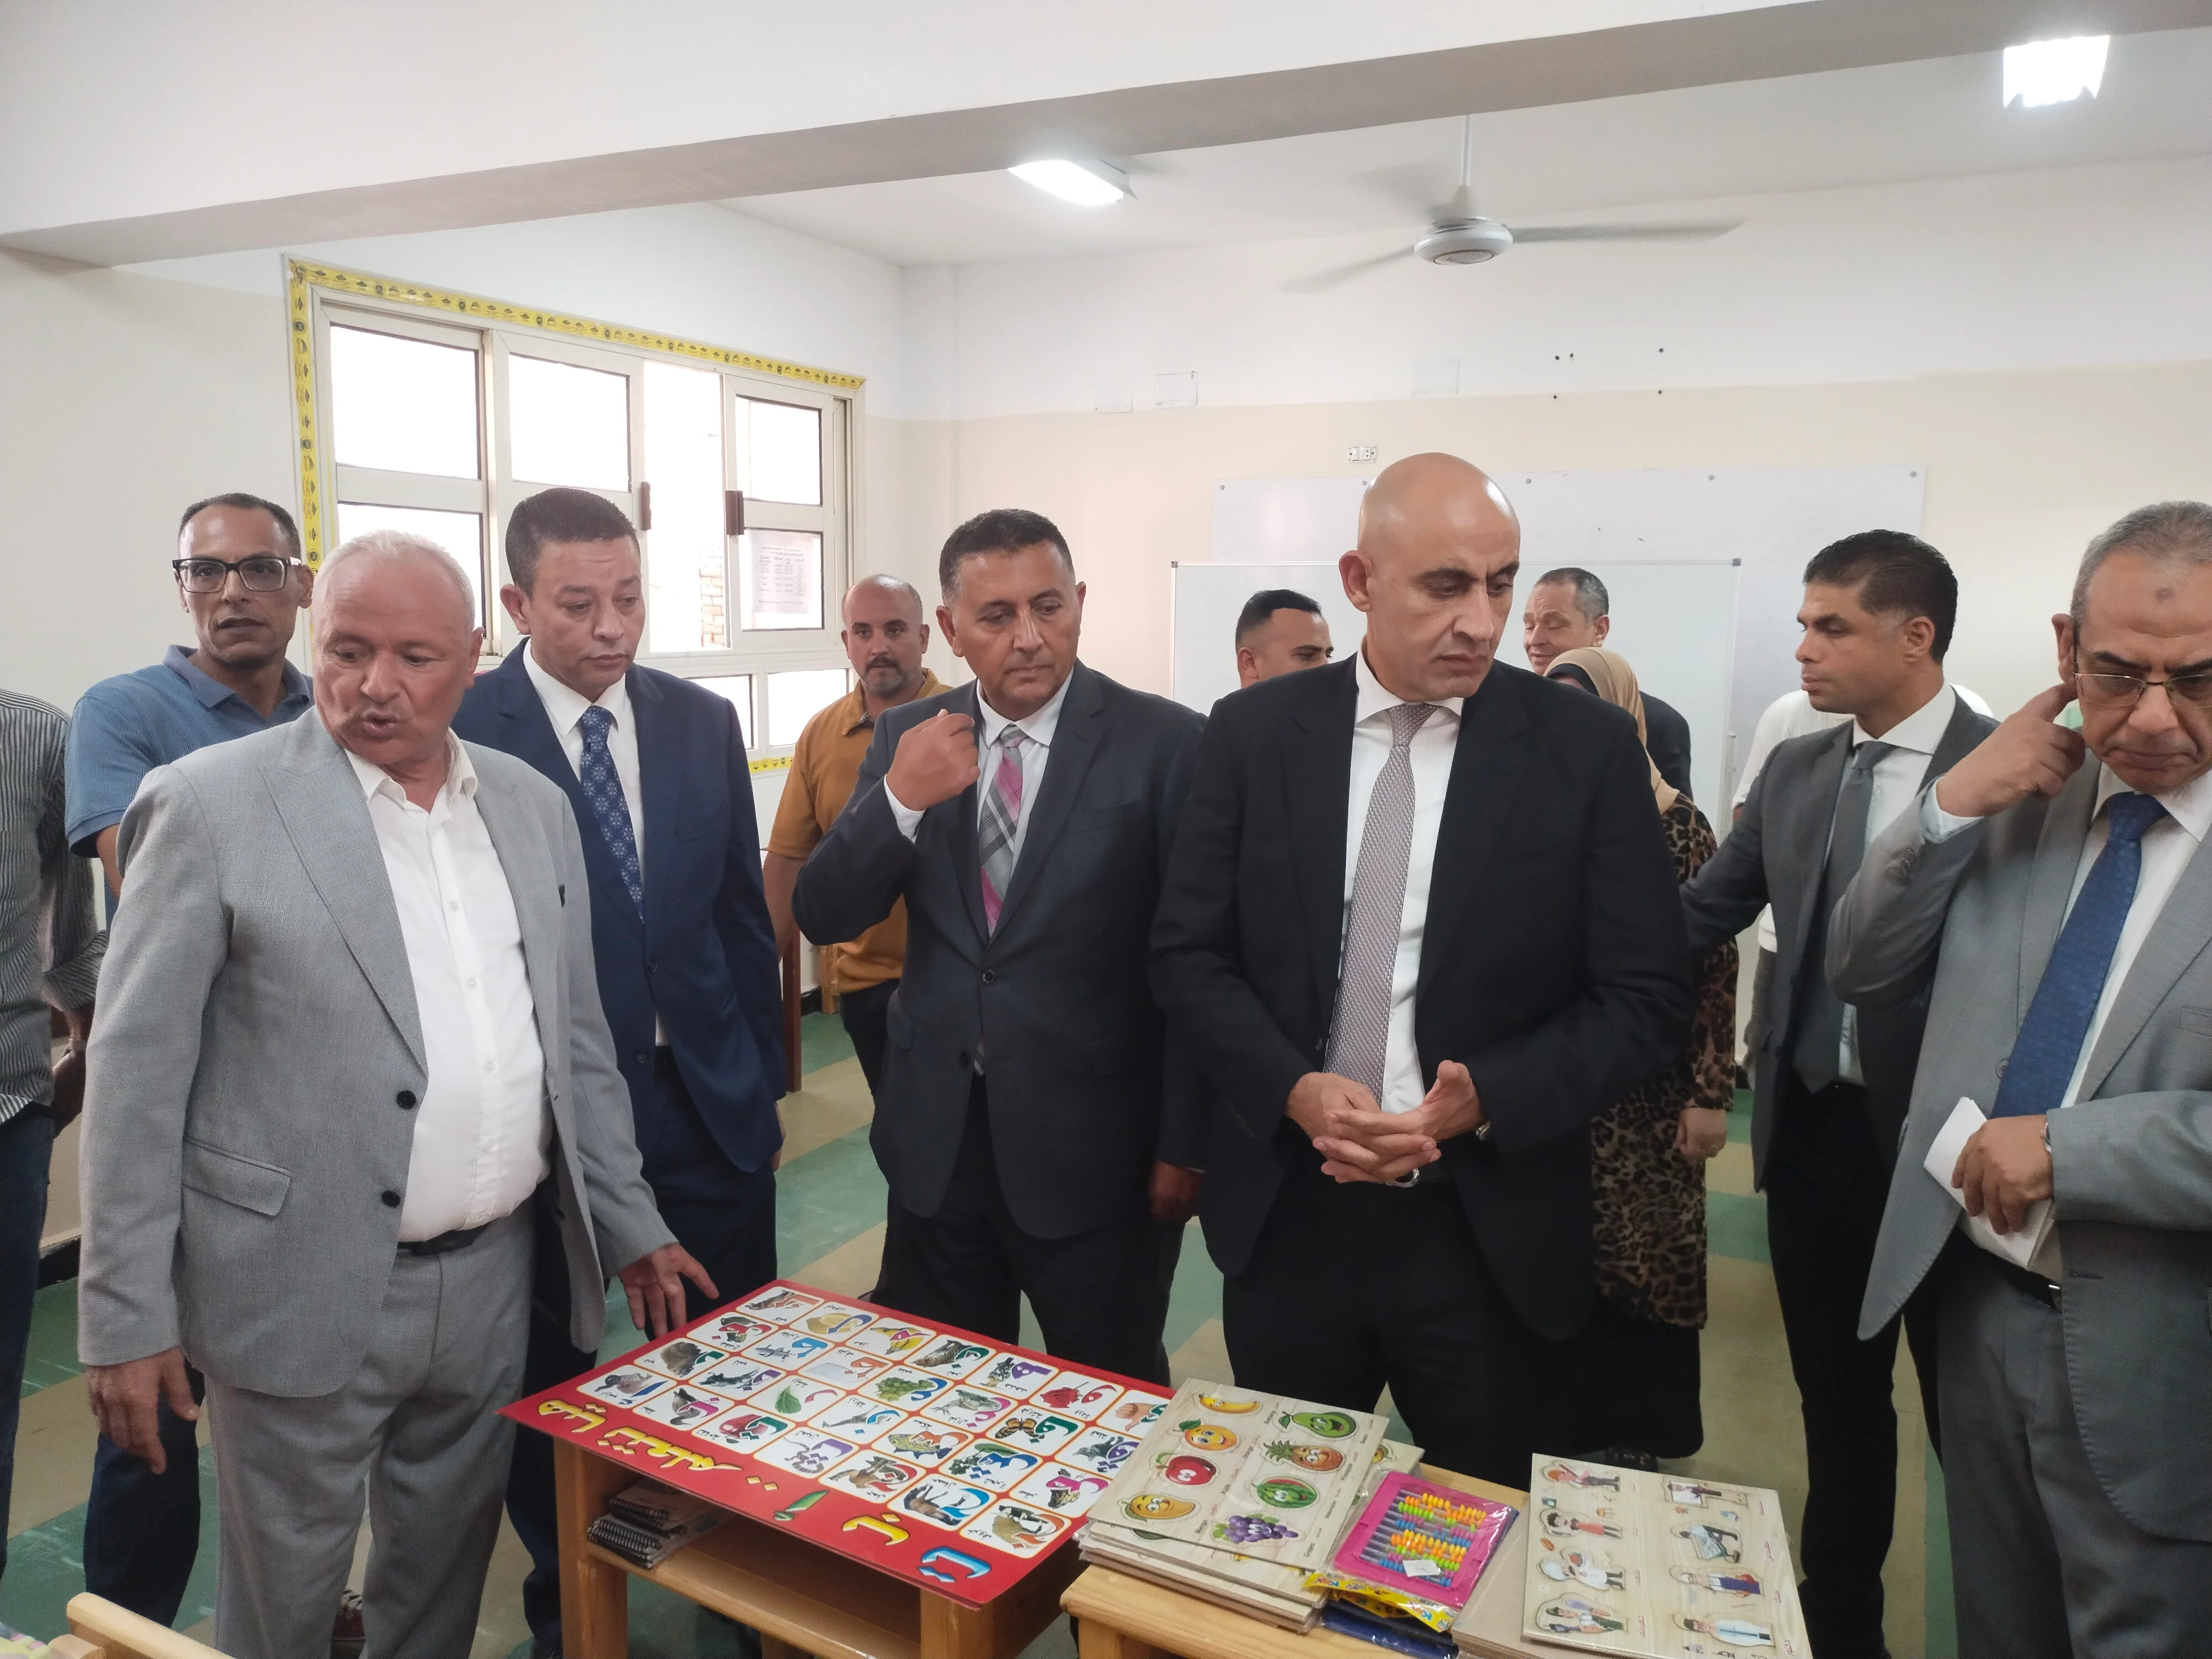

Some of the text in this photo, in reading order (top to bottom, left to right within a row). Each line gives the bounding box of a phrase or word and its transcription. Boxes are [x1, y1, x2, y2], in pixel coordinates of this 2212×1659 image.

[712, 1322, 770, 1339] ض
[828, 1314, 870, 1333] ل
[696, 1350, 727, 1364] د
[793, 1337, 830, 1358] ط
[952, 1345, 988, 1368] ن
[845, 1356, 890, 1378] ظ
[743, 1369, 784, 1391] ذ
[912, 1378, 947, 1401] ع
[805, 1389, 838, 1402] ر
[1082, 1384, 1119, 1402] و
[677, 1397, 721, 1418] ب
[967, 1397, 1010, 1428] غ
[740, 1415, 791, 1439] ت
[855, 1410, 901, 1434] ز
[1029, 1415, 1080, 1443] ف
[911, 1430, 969, 1447] س
[808, 1437, 855, 1464] ث
[971, 1451, 1037, 1479] ش
[867, 1464, 915, 1492] ج
[1047, 1474, 1107, 1491] ص
[541, 1399, 607, 1432] هيا
[596, 1426, 743, 1469] نتعلم
[774, 1491, 828, 1519] أ
[843, 1514, 908, 1545] ب
[918, 1545, 990, 1582] ت
[938, 1487, 987, 1518] ح
[1011, 1514, 1063, 1548] خ
